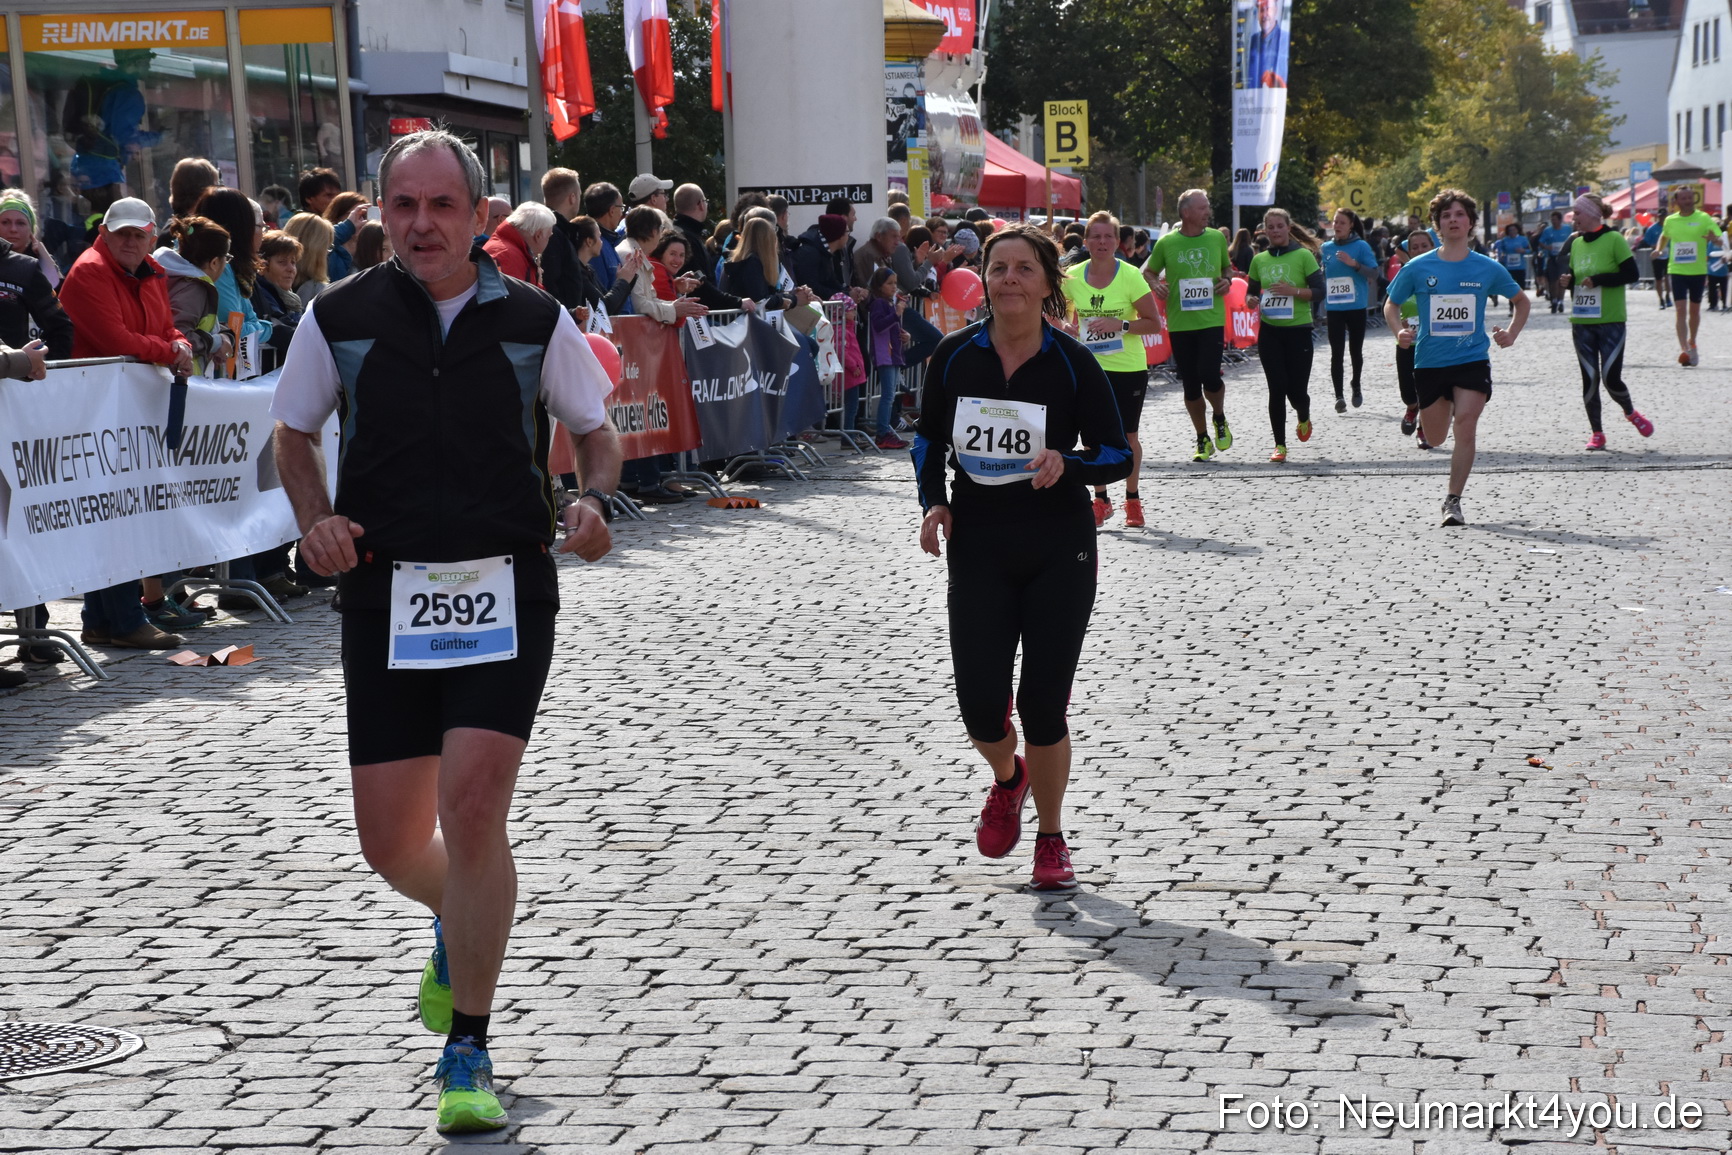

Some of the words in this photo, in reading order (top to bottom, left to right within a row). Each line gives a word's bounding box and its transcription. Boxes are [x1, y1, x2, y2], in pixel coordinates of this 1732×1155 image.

[42, 20, 209, 44] RUNMARKT.DE
[1049, 104, 1083, 116] Block
[1056, 121, 1078, 153] B
[1350, 188, 1363, 207] C
[1184, 288, 1209, 299] 2076
[1331, 284, 1351, 294] 2138
[1265, 297, 1289, 308] 2777
[1436, 307, 1469, 321] 2406
[989, 407, 1019, 417] BOCK
[965, 425, 1031, 455] 2148
[12, 437, 59, 489] BMW
[980, 461, 1016, 471] Barbara
[24, 499, 73, 535] WENIGER
[71, 487, 143, 526] VERBRAUCH.
[440, 571, 479, 582] BOCK
[410, 592, 497, 627] 2592
[430, 638, 479, 651] Günther
